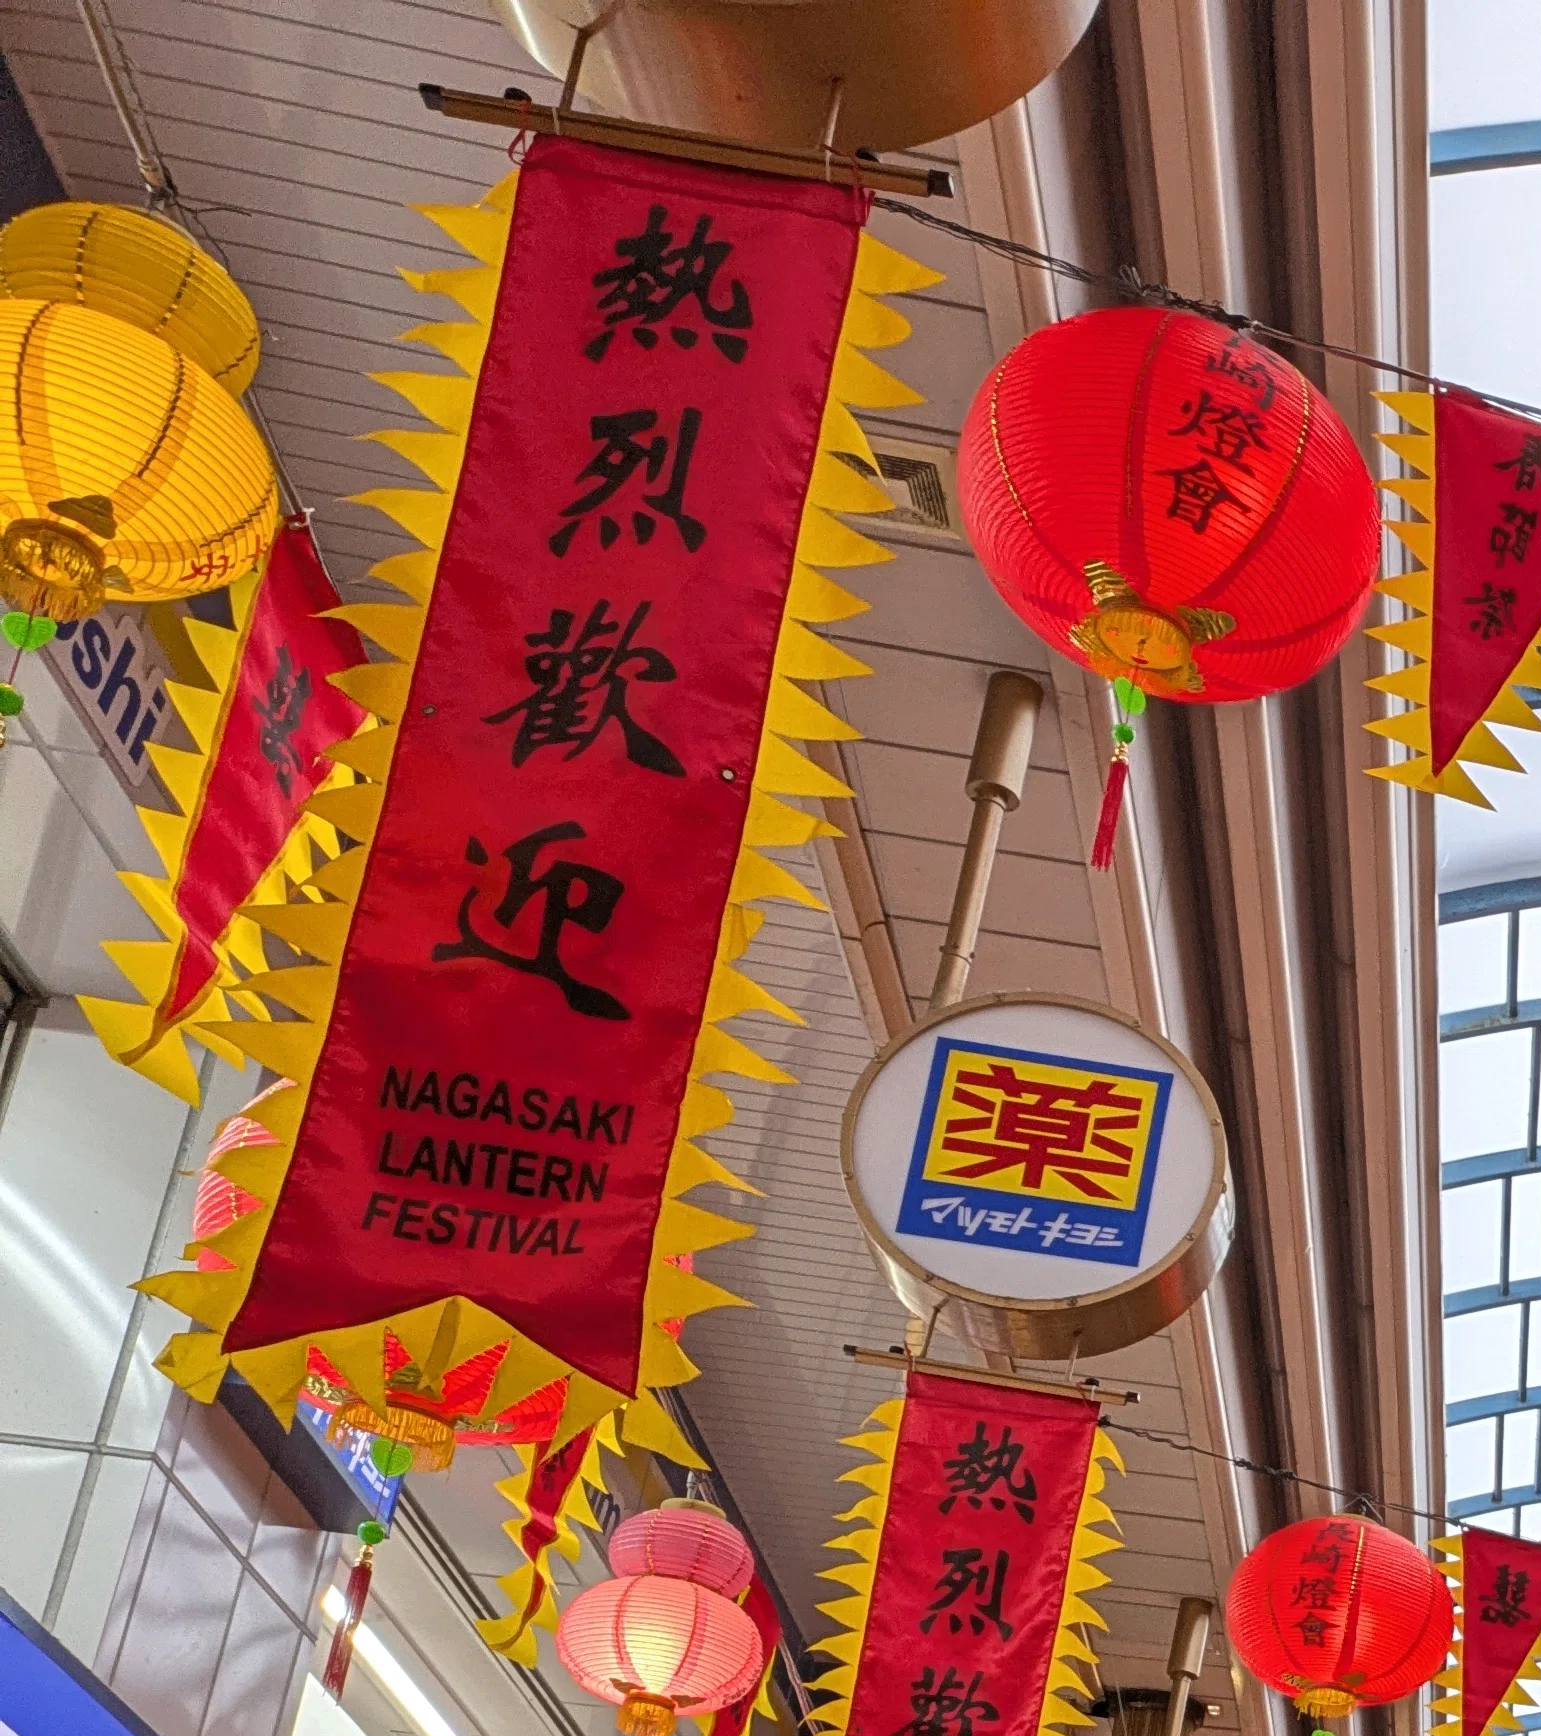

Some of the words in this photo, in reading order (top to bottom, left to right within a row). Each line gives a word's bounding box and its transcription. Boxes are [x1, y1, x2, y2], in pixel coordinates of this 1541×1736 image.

[431, 205, 754, 1020] 熱烈歡迎
[380, 1065, 634, 1146] NAGASAKI
[937, 1062, 1144, 1202] 薬
[378, 1130, 609, 1204] LANTERN
[361, 1191, 586, 1257] FESTIVAL
[920, 1196, 1125, 1248] マツモトキヨシ
